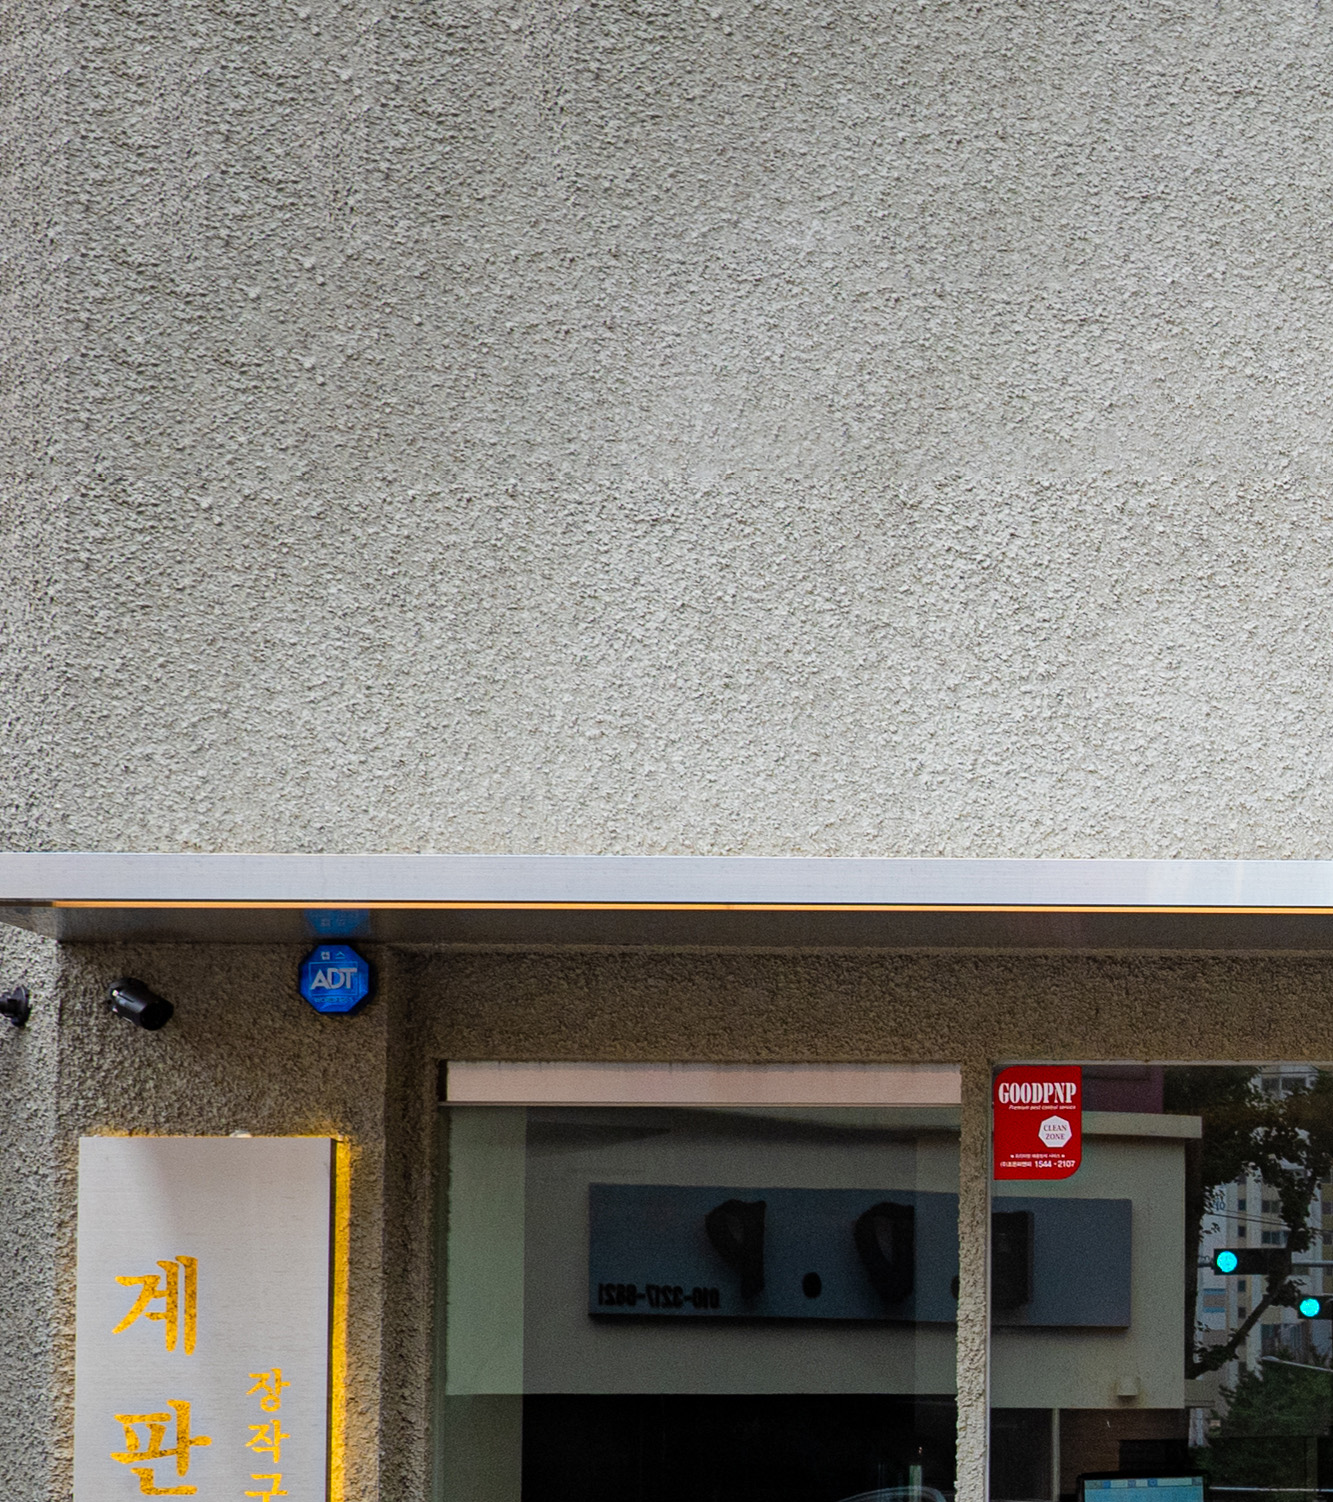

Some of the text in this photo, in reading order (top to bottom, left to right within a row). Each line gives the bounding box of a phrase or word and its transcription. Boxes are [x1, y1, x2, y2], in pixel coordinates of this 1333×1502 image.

[310, 967, 358, 990] ADT
[998, 1082, 1077, 1104] GOODPNP
[1043, 1124, 1068, 1132] CLEAN
